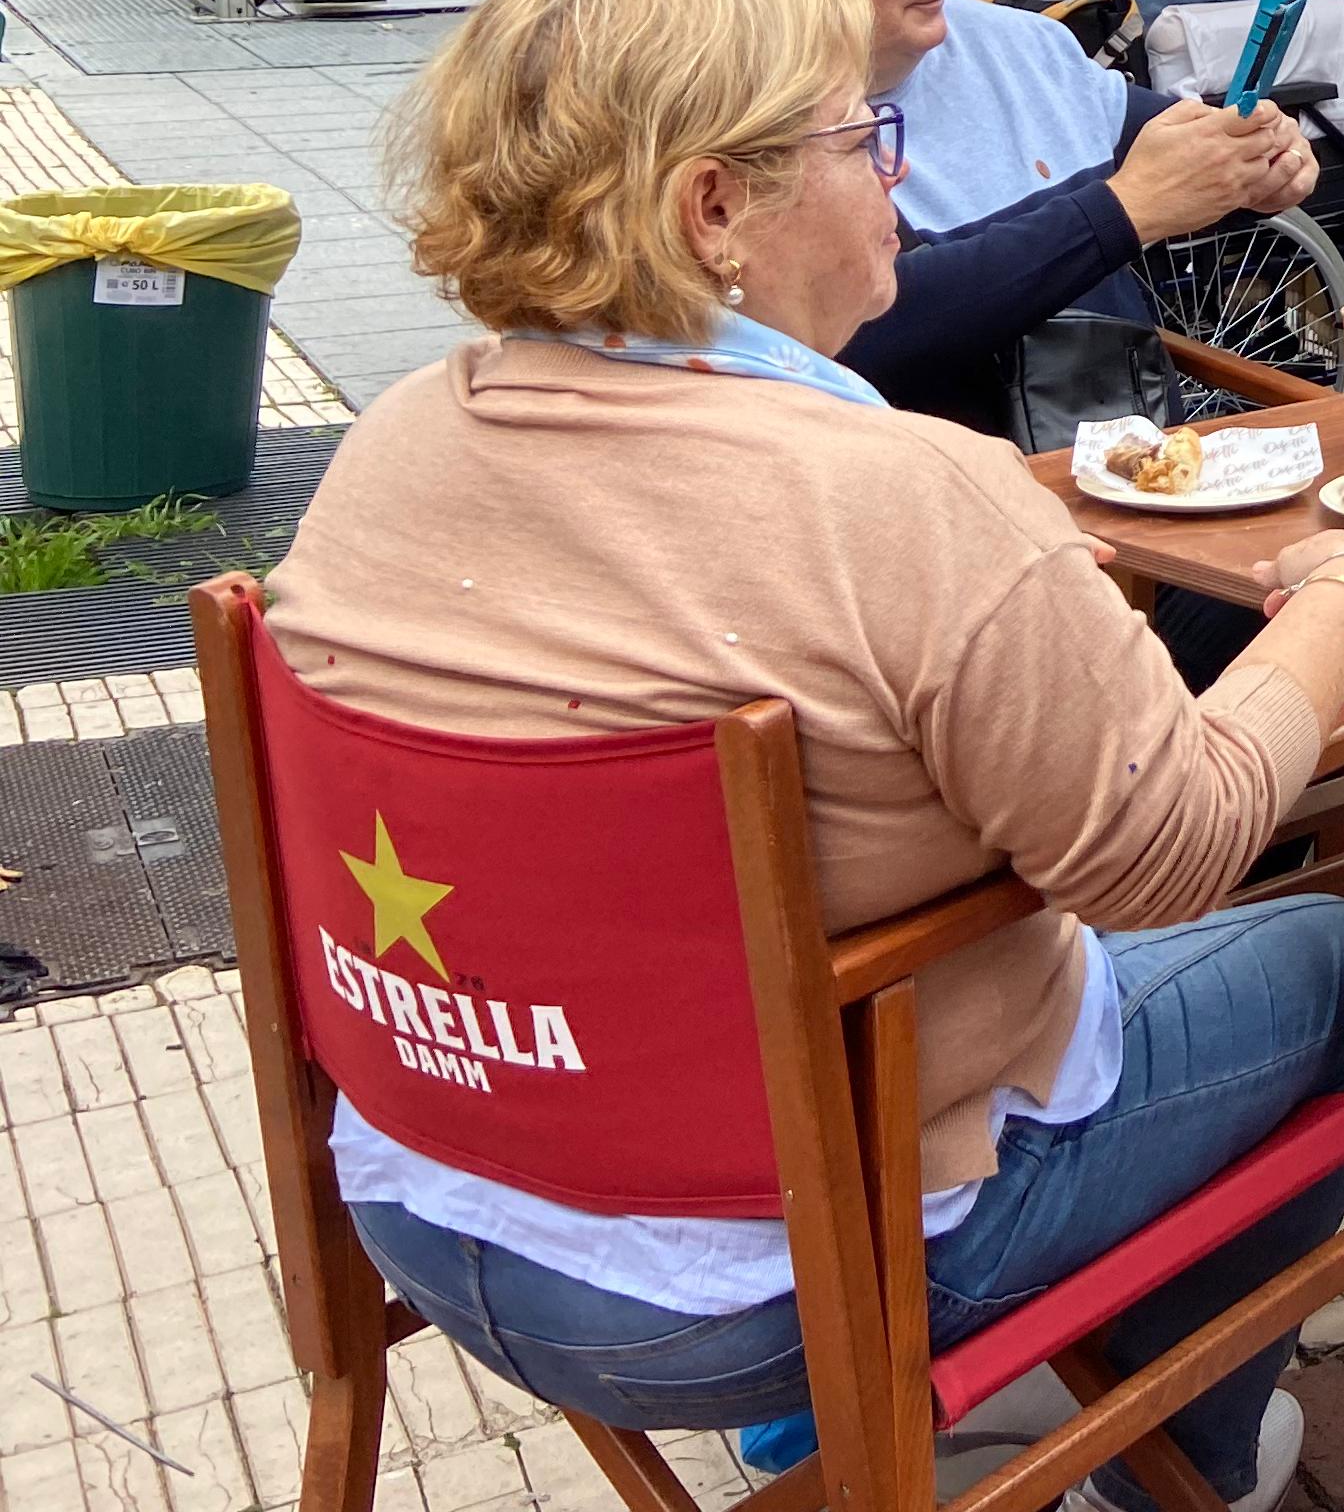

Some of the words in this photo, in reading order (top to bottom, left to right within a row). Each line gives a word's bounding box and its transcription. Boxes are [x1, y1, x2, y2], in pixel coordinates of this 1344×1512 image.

[131, 279, 149, 291] 50
[151, 279, 160, 291] L
[318, 923, 587, 1071] ESTRELLA
[392, 1035, 493, 1093] DAMM
